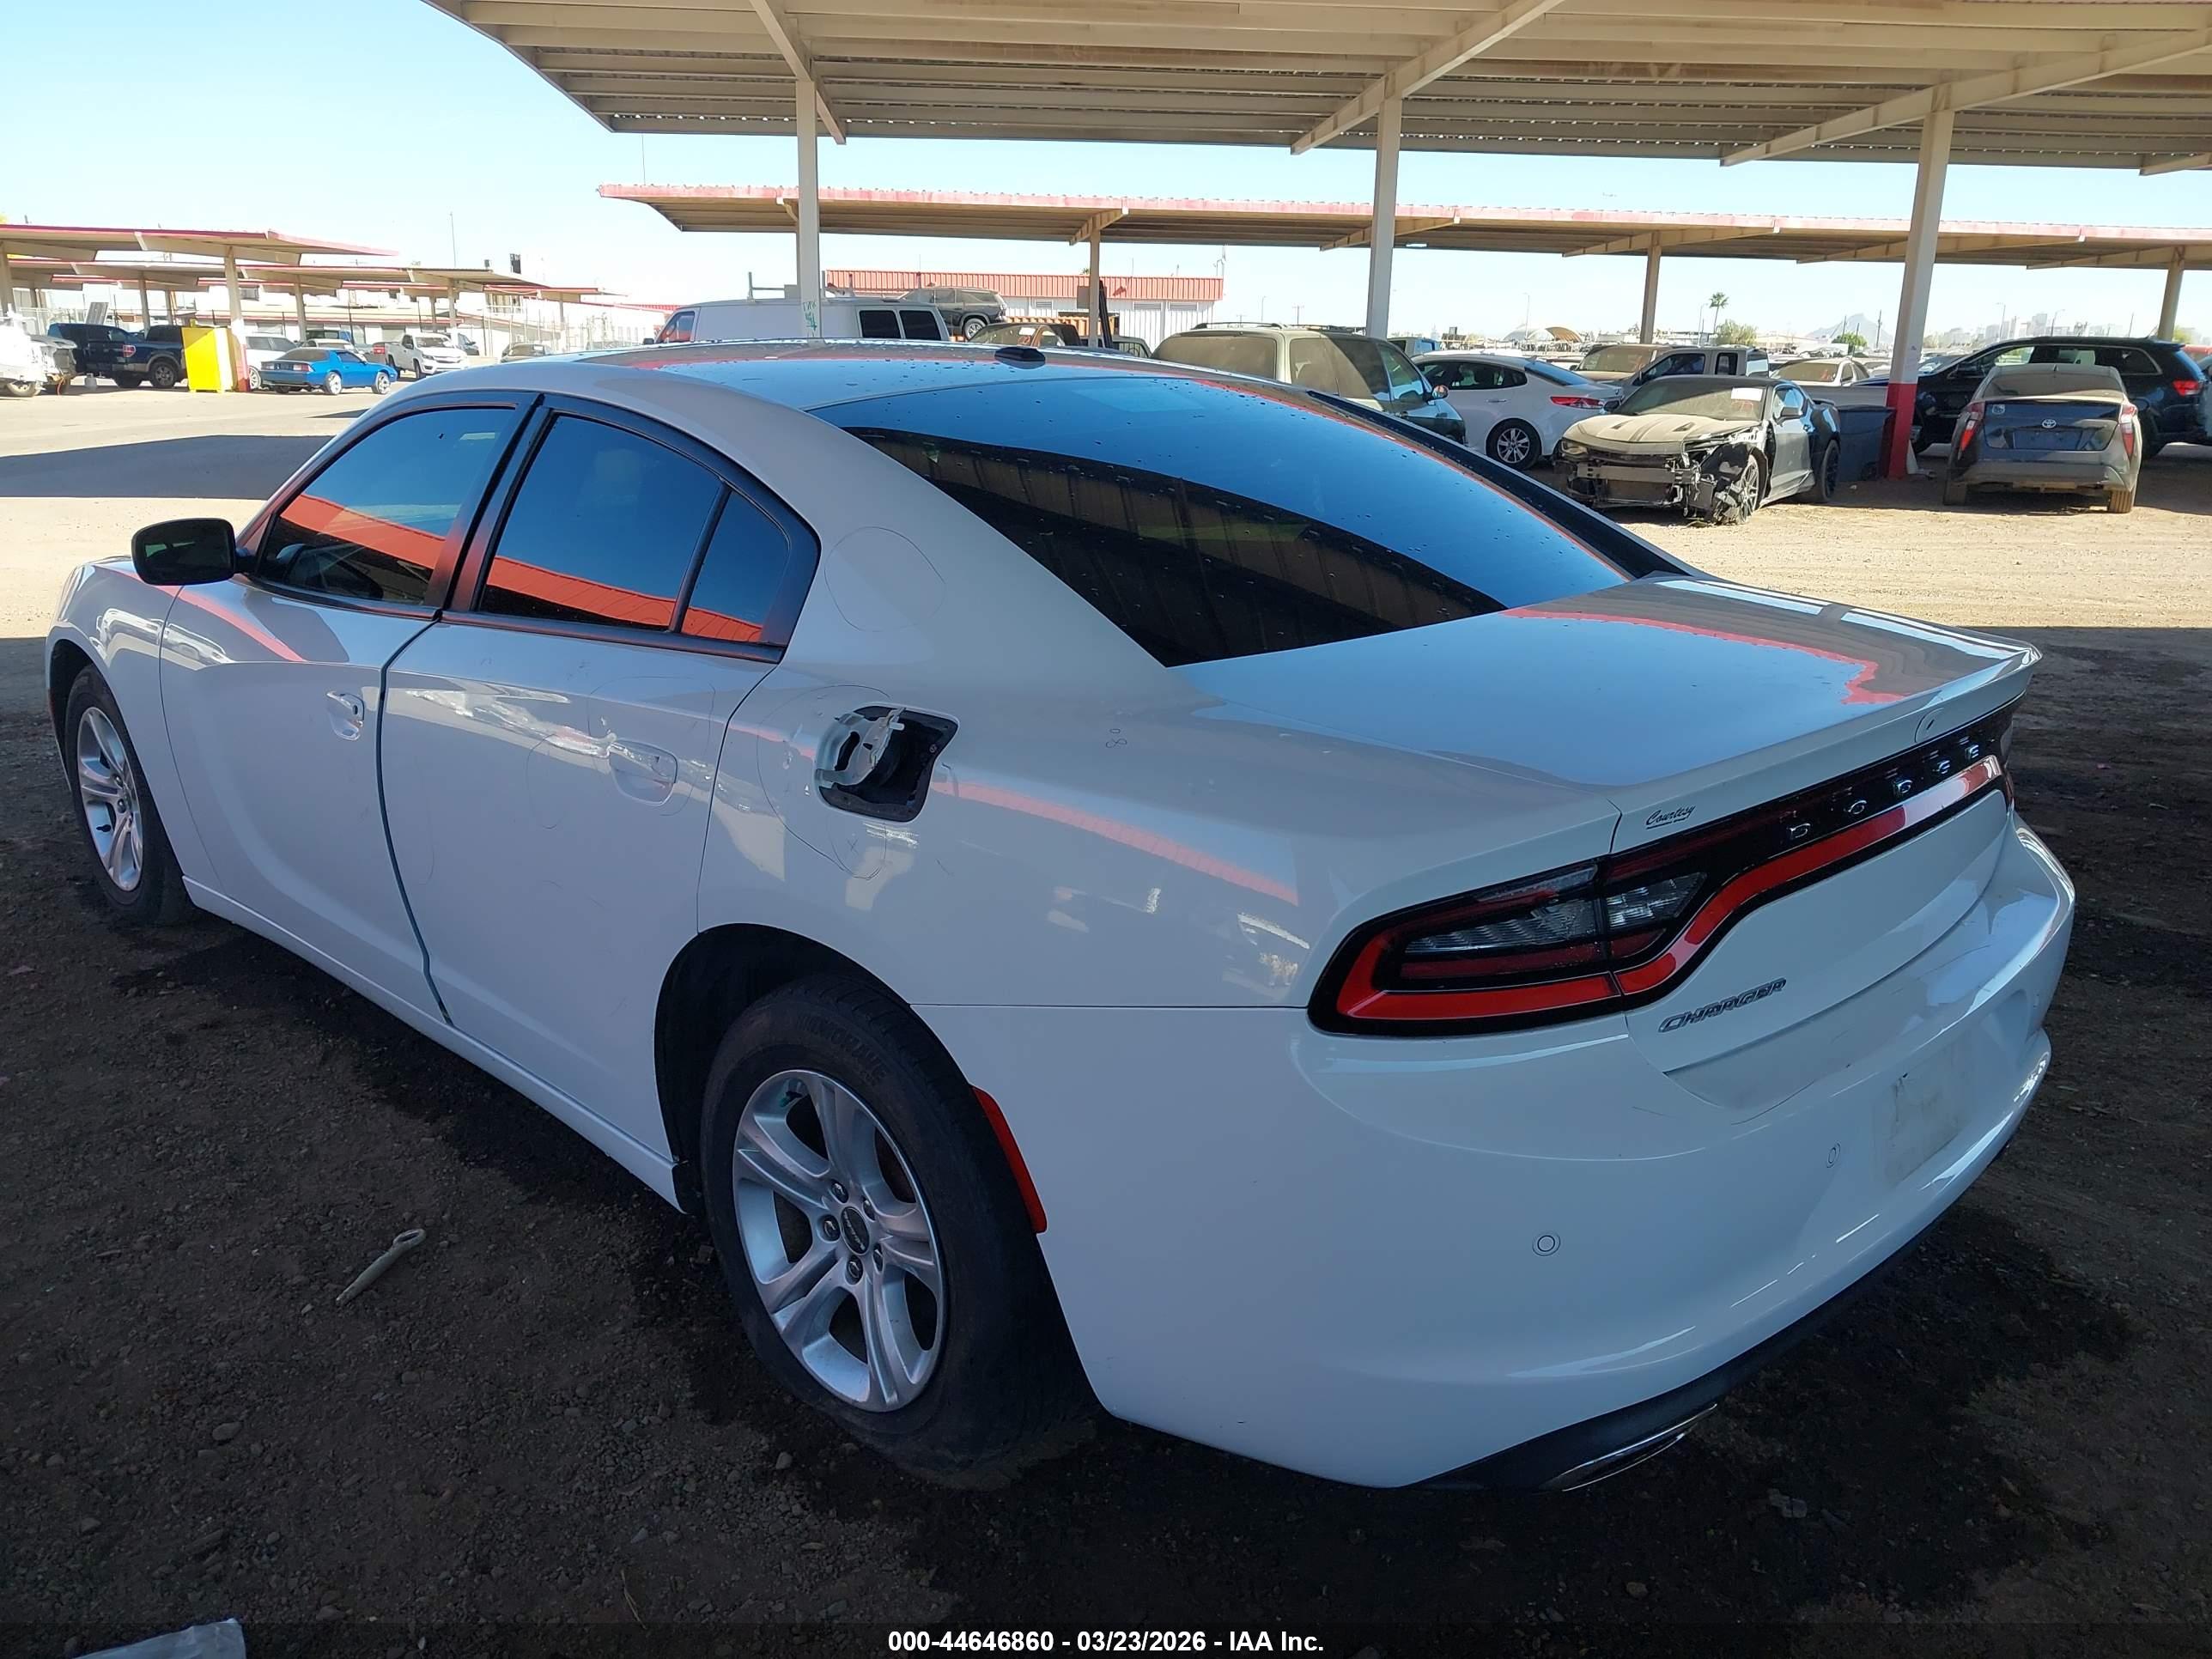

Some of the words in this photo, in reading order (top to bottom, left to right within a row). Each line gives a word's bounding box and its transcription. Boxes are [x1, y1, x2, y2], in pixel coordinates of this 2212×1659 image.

[1646, 805, 1696, 830] Courtesy
[1789, 744, 1979, 839] DODGE
[1658, 977, 1787, 1033] CHARGER
